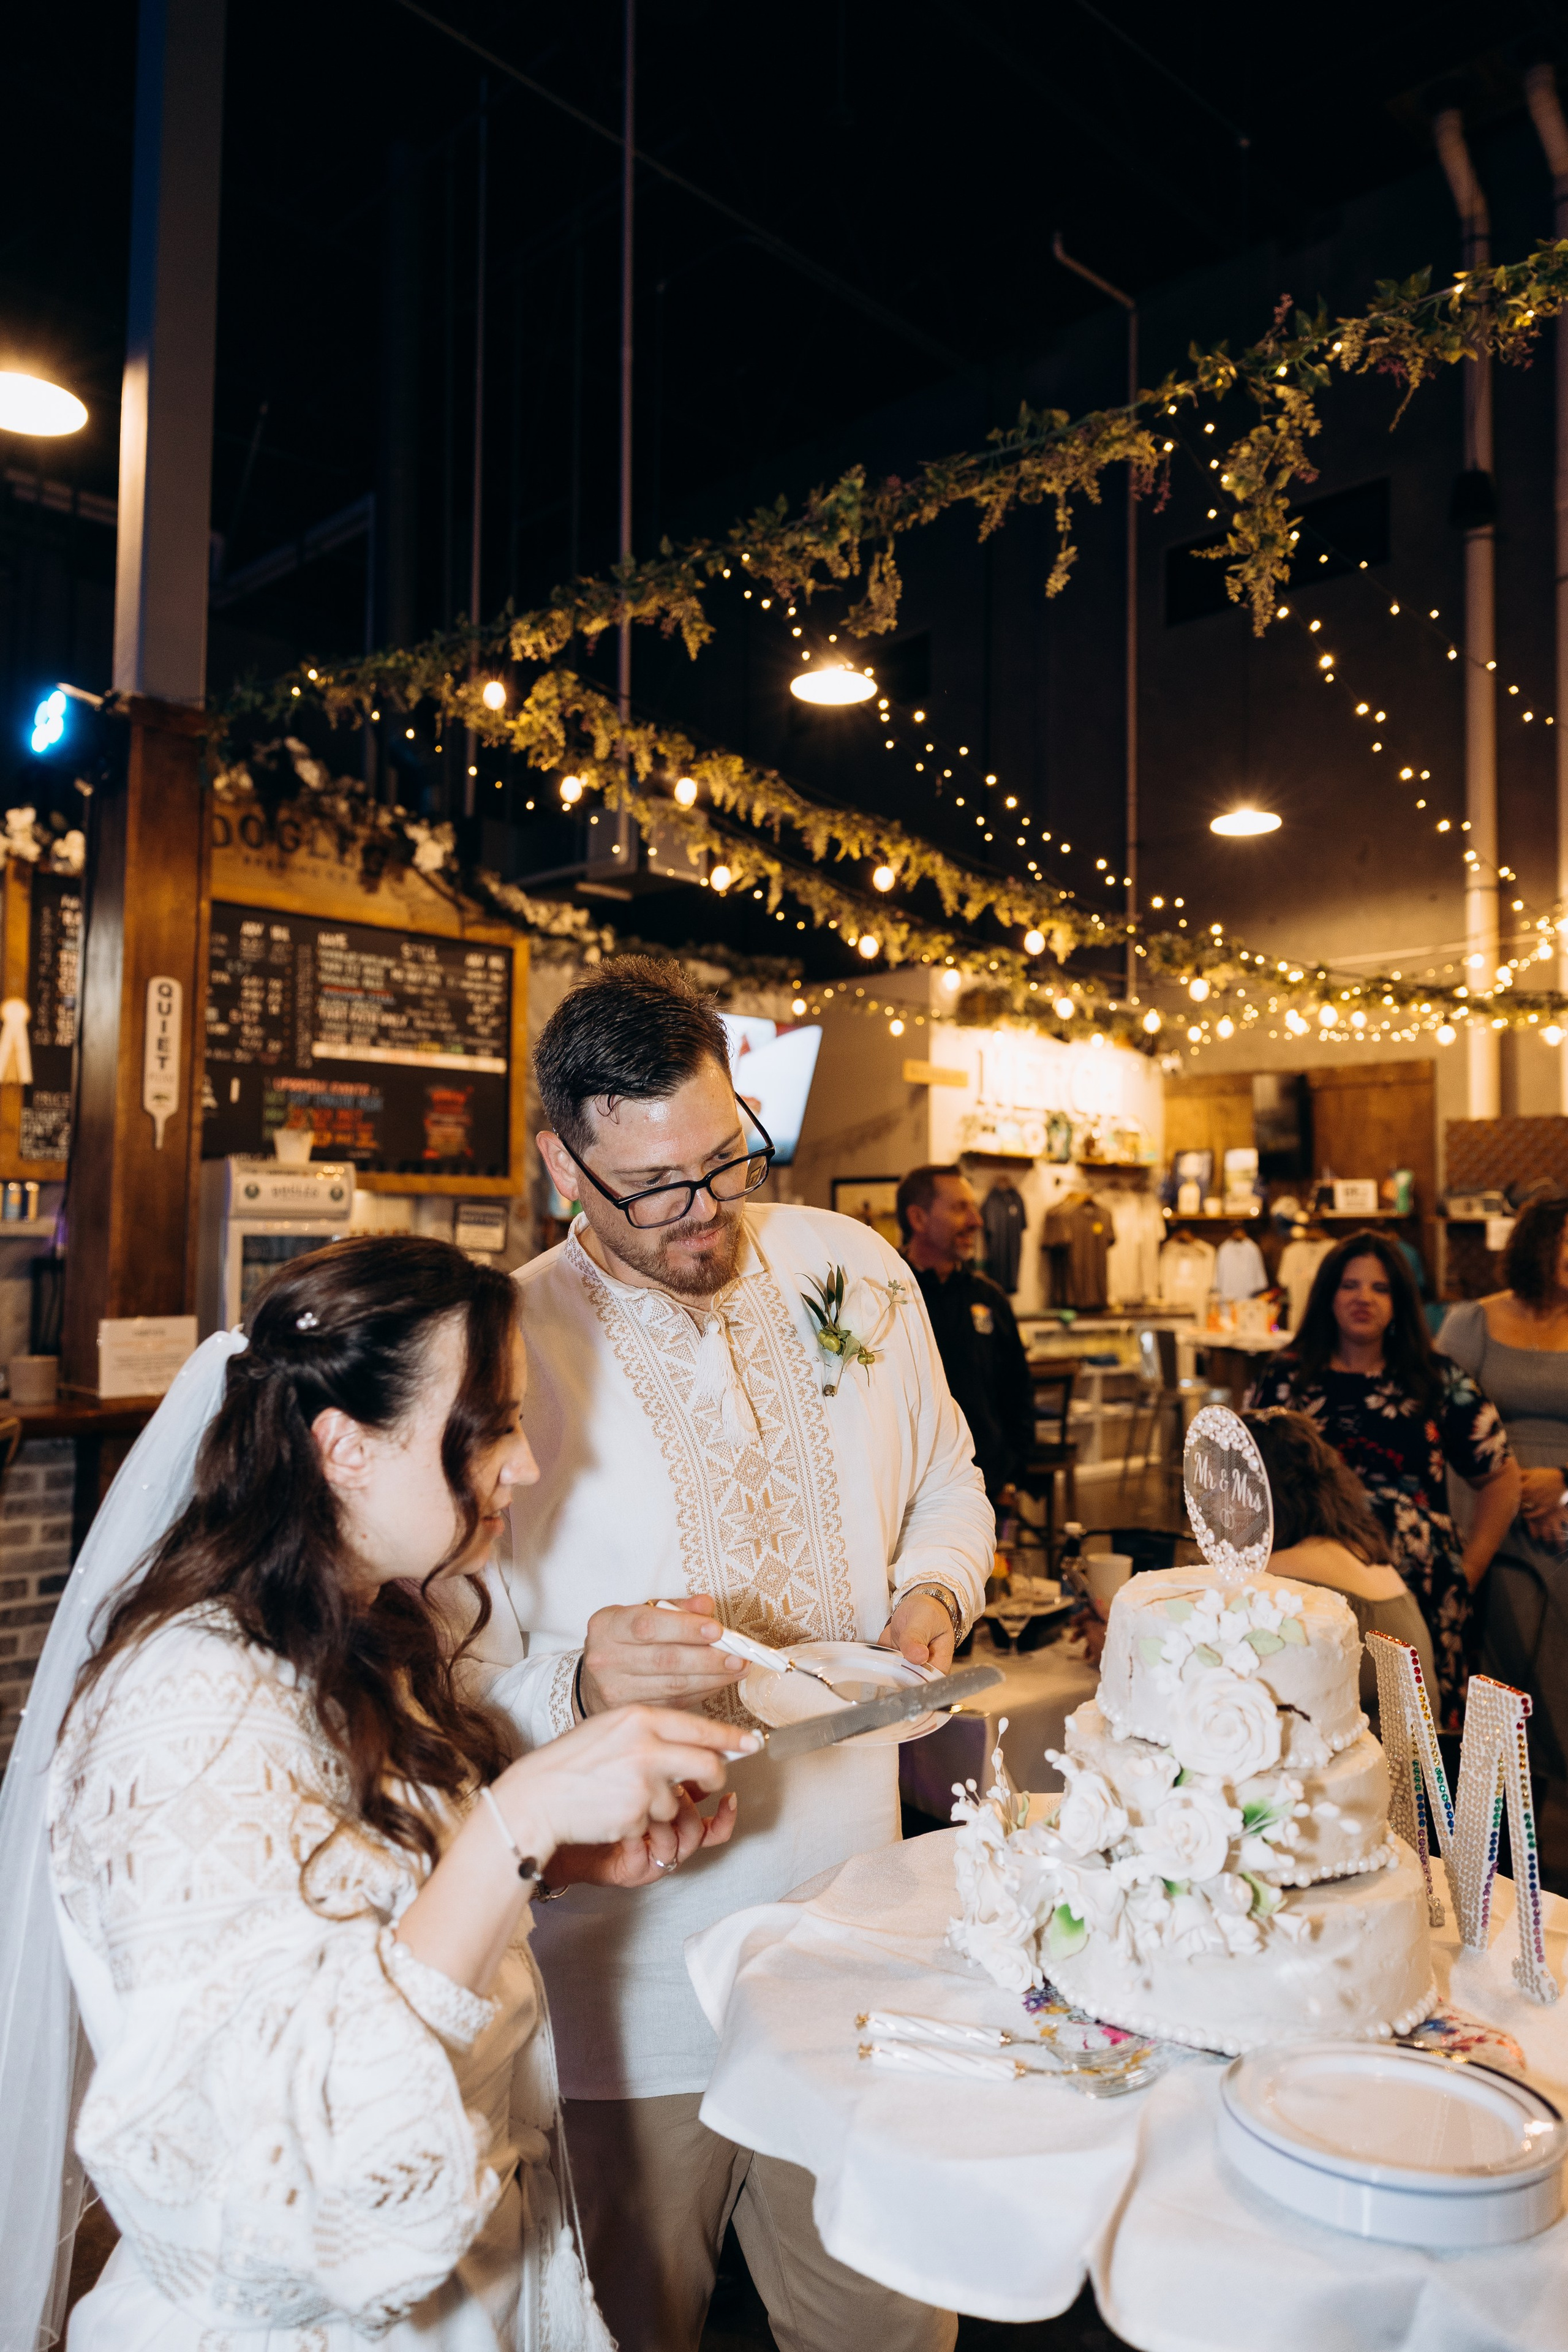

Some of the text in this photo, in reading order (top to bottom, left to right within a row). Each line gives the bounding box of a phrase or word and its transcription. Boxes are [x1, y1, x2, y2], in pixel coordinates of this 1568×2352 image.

[157, 982, 173, 1070] QUIET
[1194, 1452, 1217, 1490] Mr
[1231, 1468, 1262, 1513] Mrs
